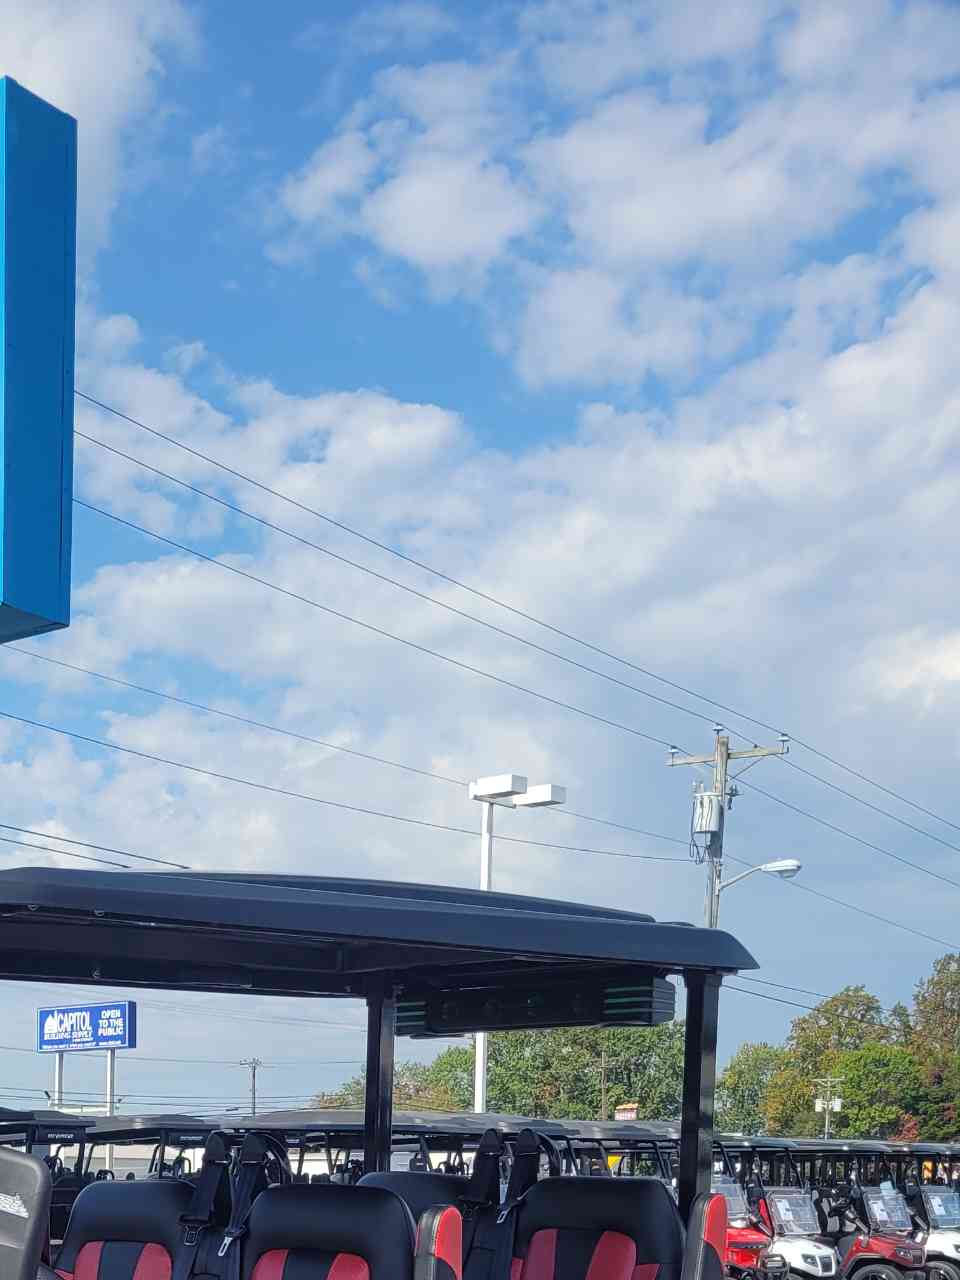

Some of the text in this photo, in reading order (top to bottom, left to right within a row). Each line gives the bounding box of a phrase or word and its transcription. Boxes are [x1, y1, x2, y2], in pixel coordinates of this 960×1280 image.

[101, 1009, 121, 1018] OPEN
[57, 1011, 92, 1032] CAPITOL
[98, 1018, 124, 1027] TO THE
[98, 1027, 124, 1037] PUBLIC
